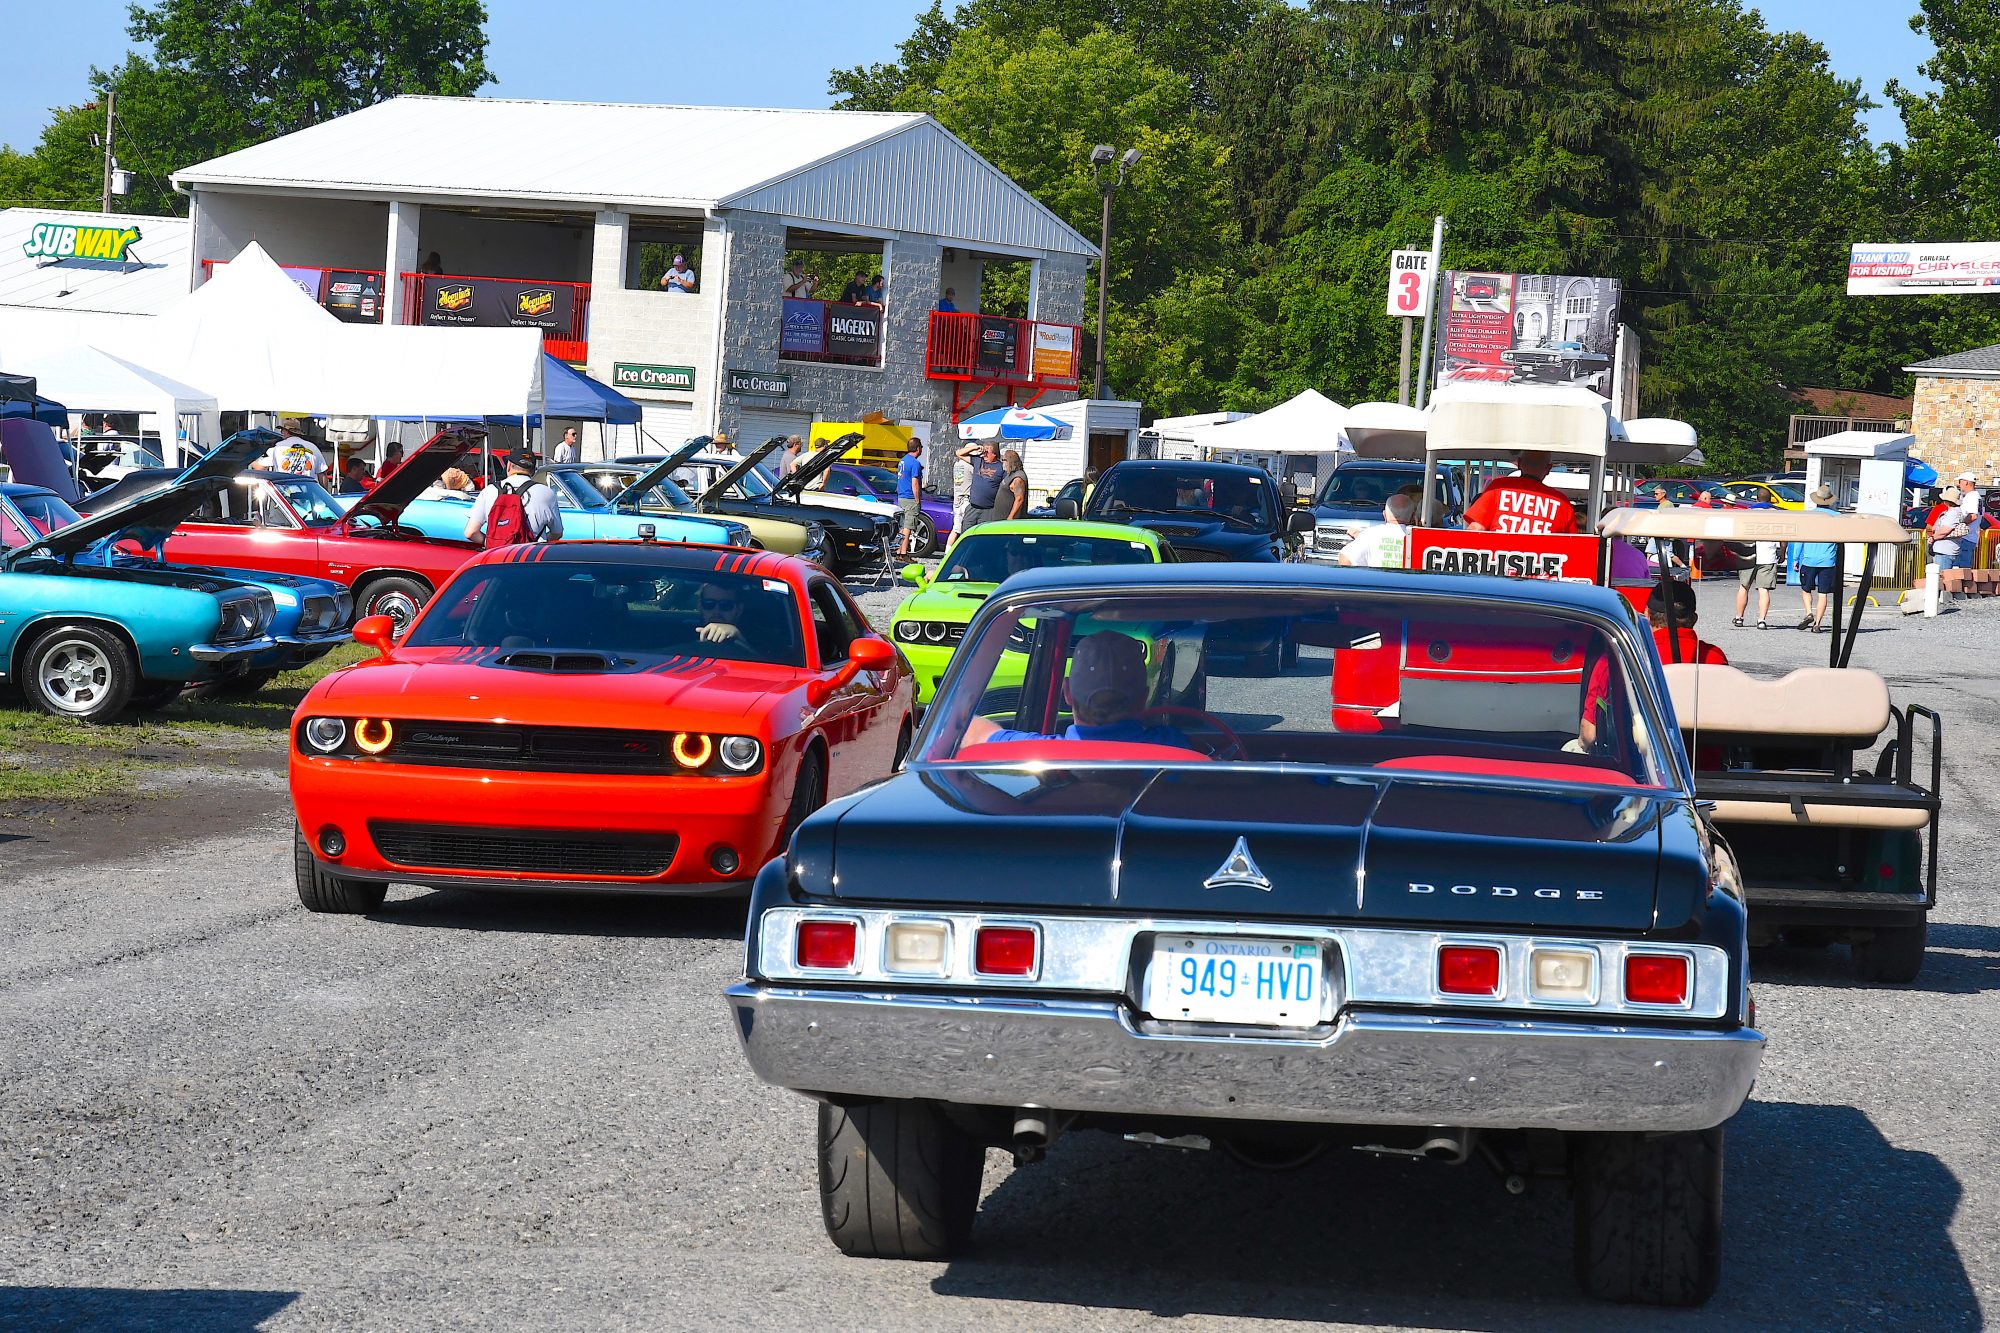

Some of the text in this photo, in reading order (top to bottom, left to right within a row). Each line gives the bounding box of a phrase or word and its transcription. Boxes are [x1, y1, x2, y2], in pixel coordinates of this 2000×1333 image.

[25, 224, 137, 259] SUBWAY
[1396, 255, 1427, 270] GATE
[1853, 253, 1907, 263] THANK YOU
[1918, 261, 2000, 271] CHRYSLER
[1851, 266, 1912, 276] FOR VISITING
[439, 287, 471, 306] Meguiar's
[1398, 272, 1420, 311] 3
[520, 292, 552, 311] Meguiar's
[831, 317, 876, 336] HAGERTY
[617, 367, 690, 385] Ice Cream
[732, 375, 787, 392] Ice Cream
[1499, 490, 1561, 520] EVENT
[1496, 514, 1552, 534] STAFF
[1426, 550, 1559, 580] CARLISLE
[412, 732, 459, 744] Challenger
[1408, 883, 1603, 900] DODGE
[1205, 941, 1271, 957] ONTARIO
[1181, 957, 1313, 1001] 949 HVD
